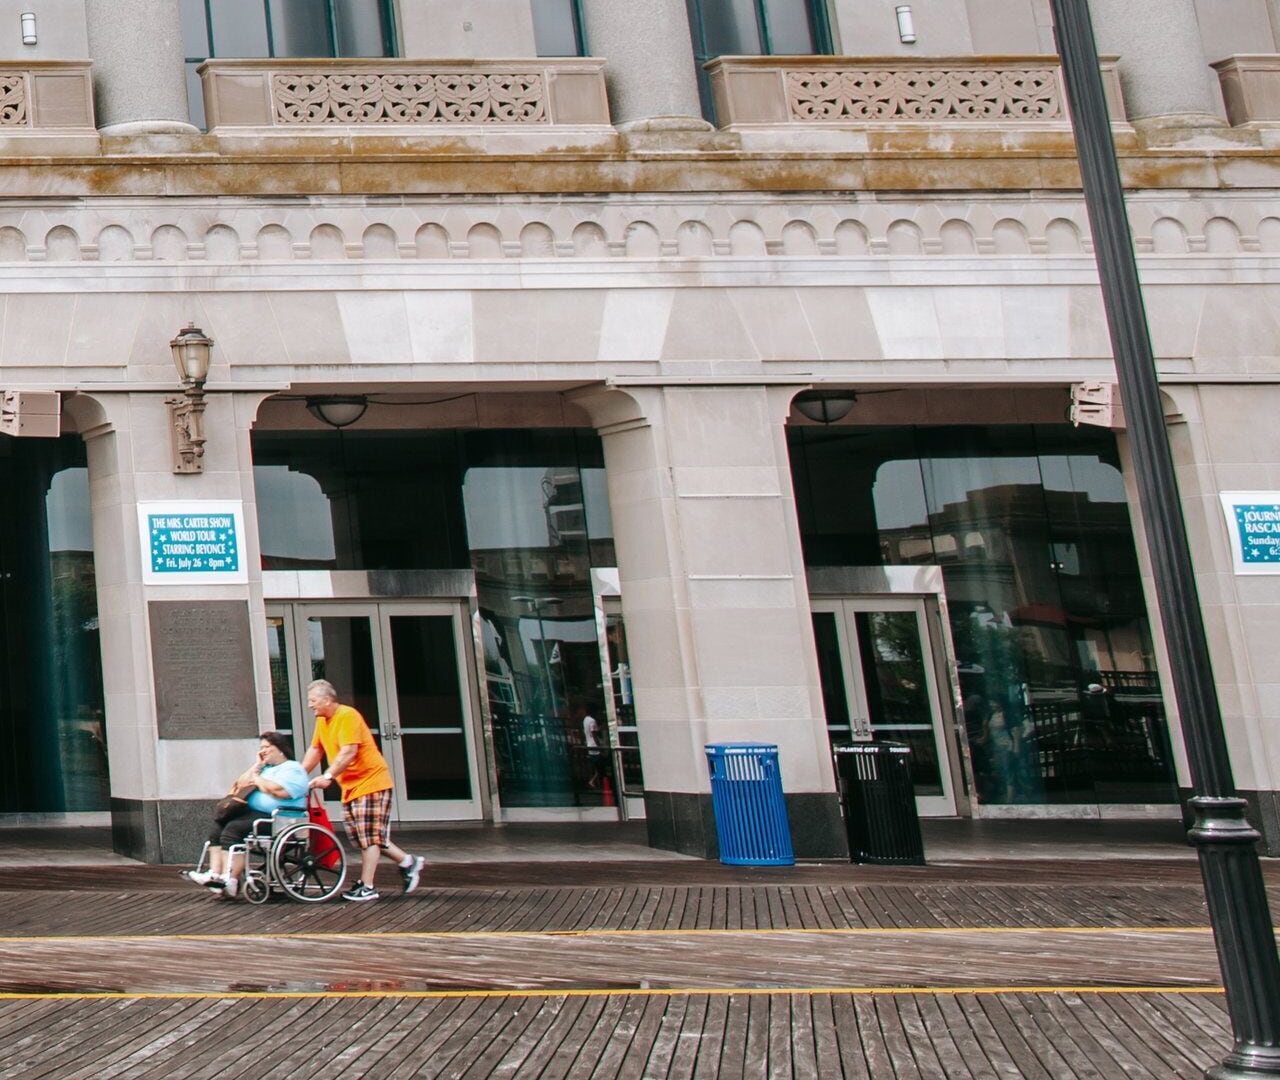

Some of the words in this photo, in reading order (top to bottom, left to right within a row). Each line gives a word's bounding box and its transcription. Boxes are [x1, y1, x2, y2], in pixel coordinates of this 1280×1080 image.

[152, 517, 167, 529] THE
[167, 517, 183, 529] MRS.
[183, 517, 209, 529] CARTER
[210, 517, 231, 529] SHOW
[170, 530, 196, 542] WORLD
[196, 530, 217, 542] TOUR
[162, 543, 195, 555] STARRING
[195, 543, 226, 555] BEYONCE
[166, 557, 177, 568] Fri.
[178, 557, 191, 570] July
[192, 558, 202, 568] 26
[208, 557, 225, 570] 8pm
